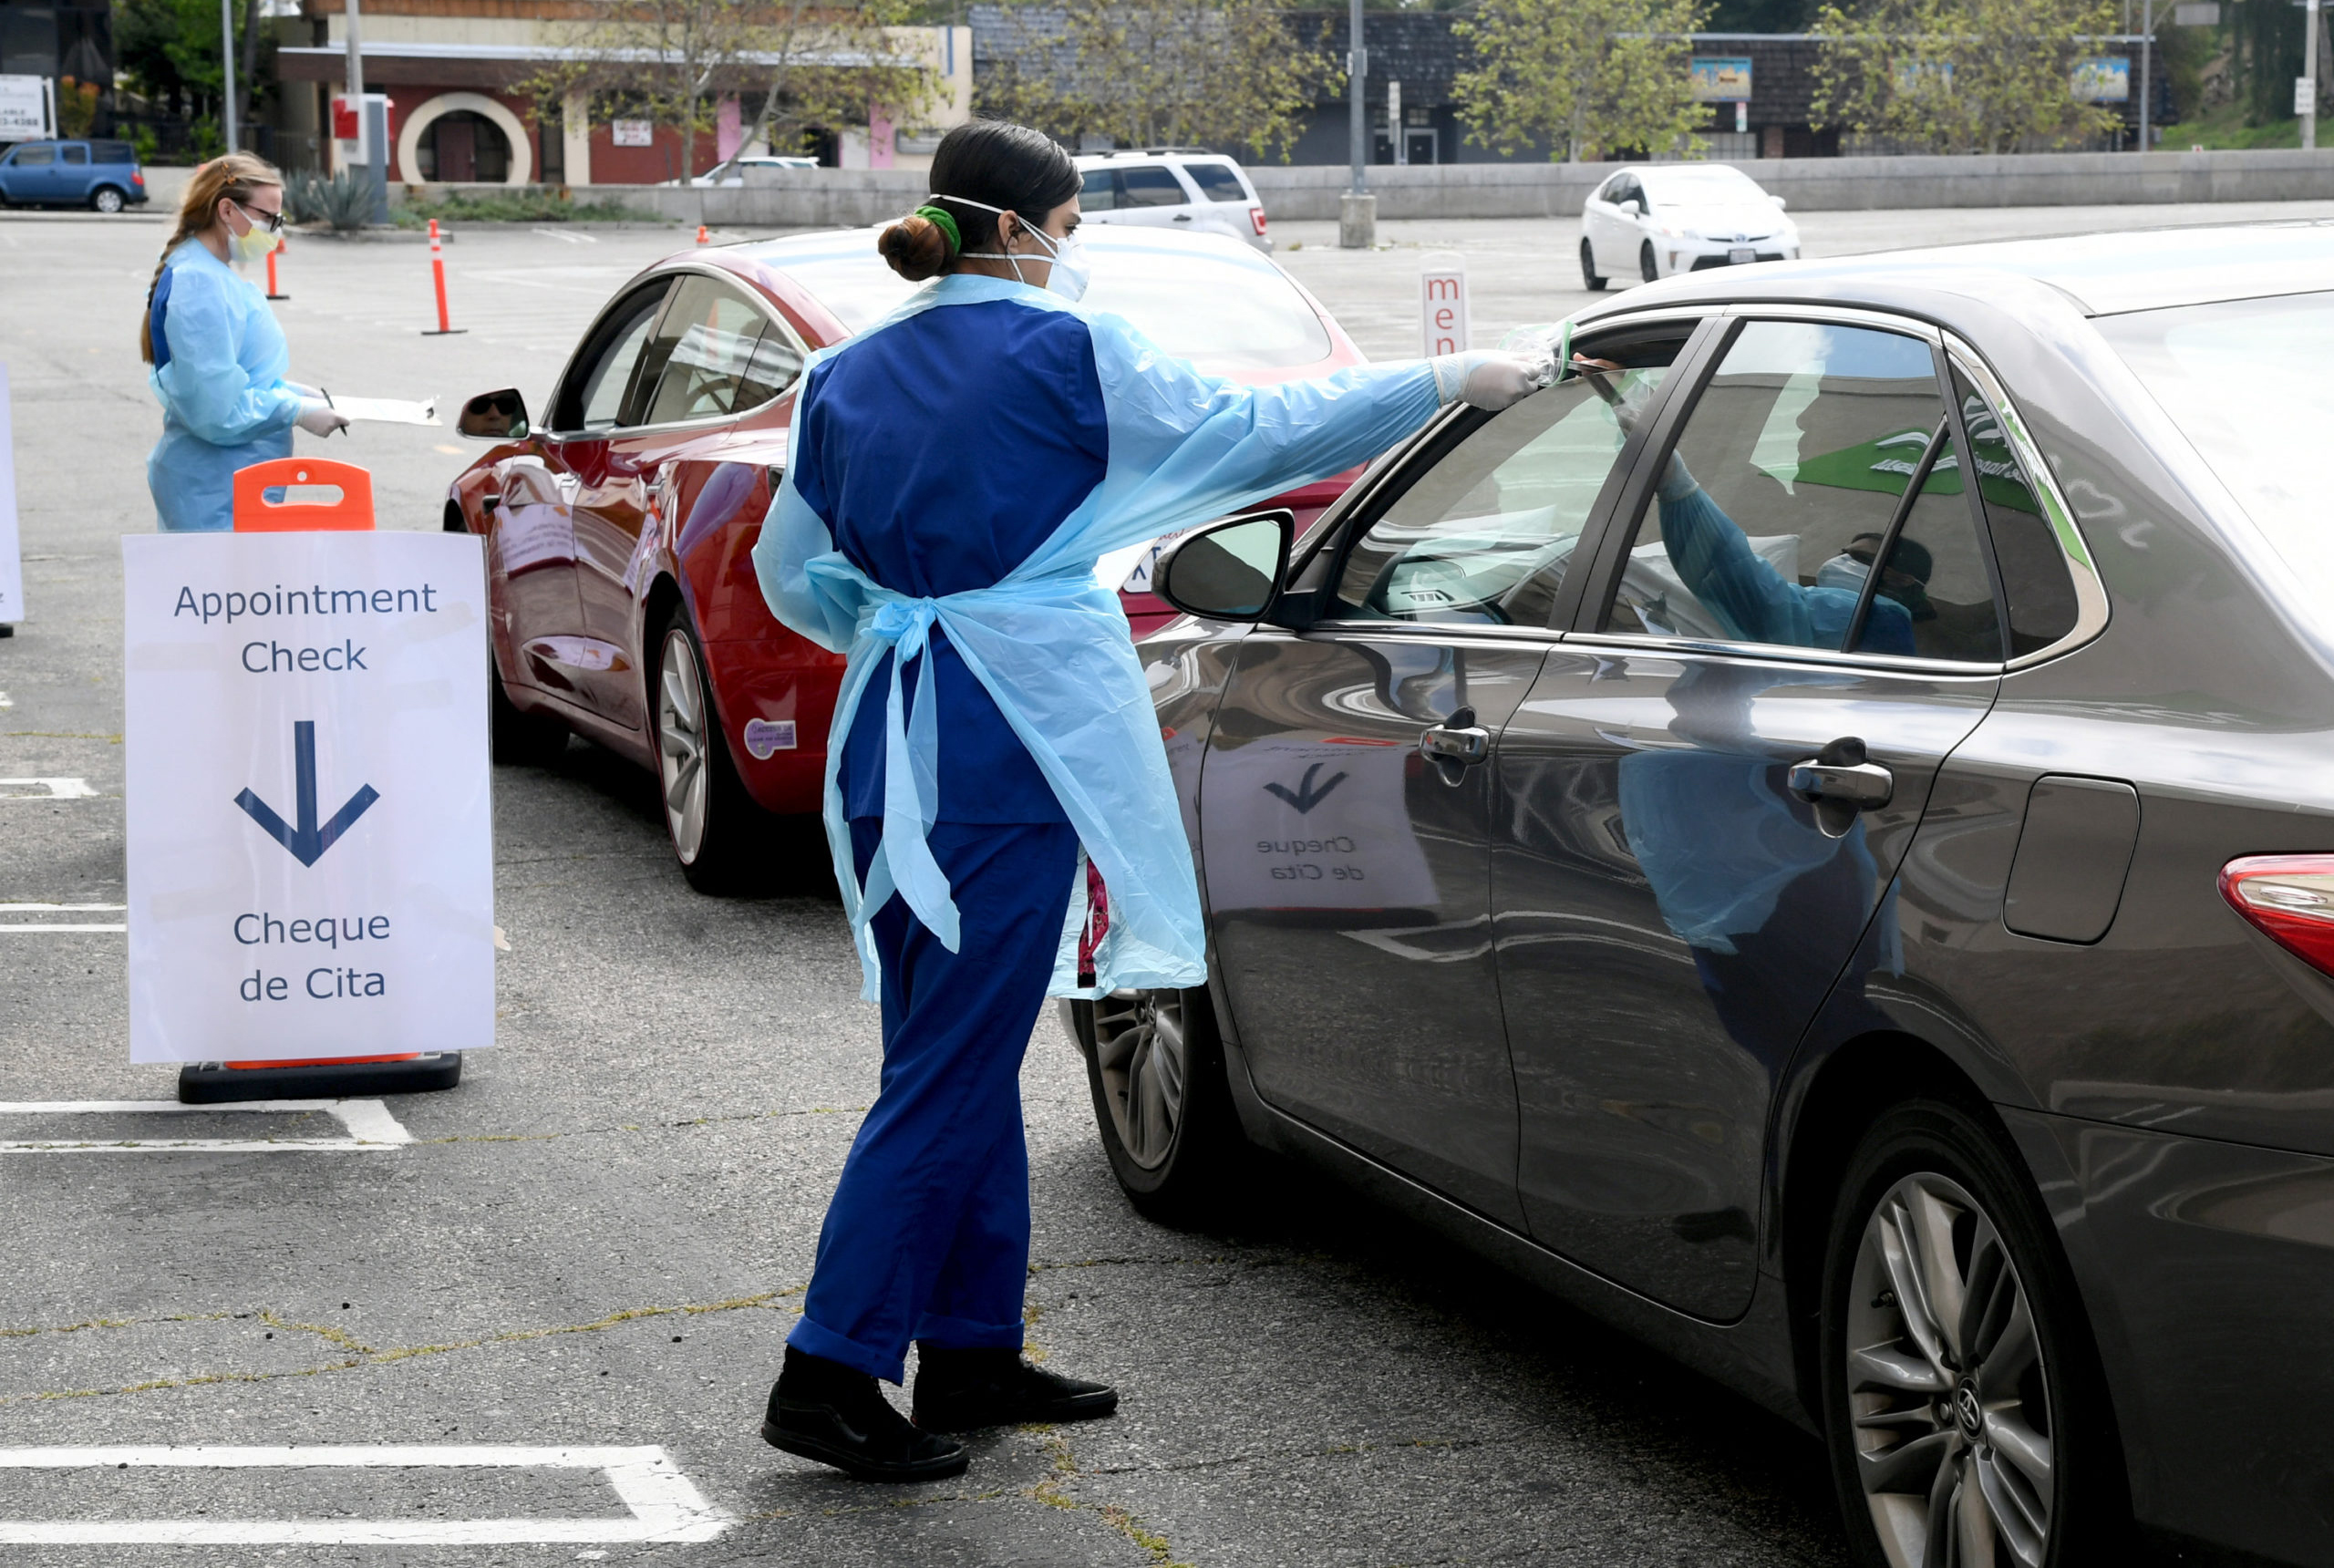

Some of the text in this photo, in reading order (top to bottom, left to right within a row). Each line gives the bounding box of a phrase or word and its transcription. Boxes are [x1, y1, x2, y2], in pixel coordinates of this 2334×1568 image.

[1428, 279, 1458, 356] men
[174, 583, 438, 624] Appointment
[242, 639, 368, 673] Check
[233, 913, 390, 950] Cheque
[240, 967, 385, 1002] de Cita
